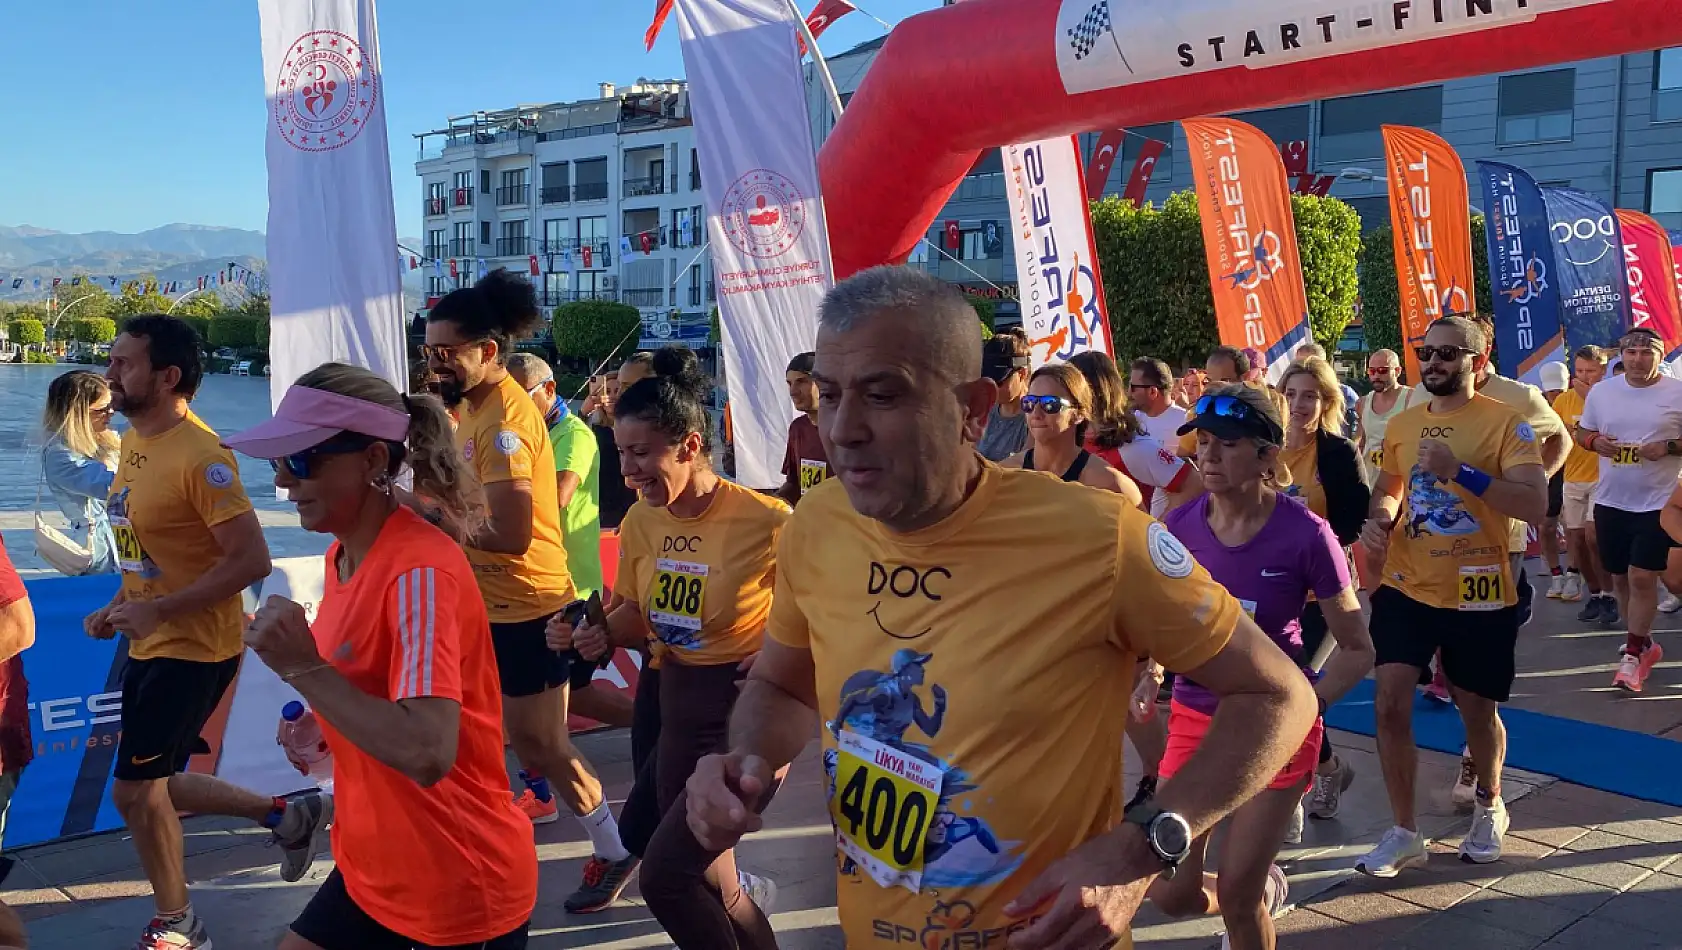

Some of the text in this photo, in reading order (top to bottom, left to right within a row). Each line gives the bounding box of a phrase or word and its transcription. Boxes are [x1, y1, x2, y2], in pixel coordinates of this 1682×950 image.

[1177, 0, 1528, 67] START-FIN
[1420, 427, 1454, 439] DOC
[662, 535, 702, 553] DOC
[655, 573, 702, 615] 308
[867, 561, 952, 600] DOC
[1462, 575, 1500, 602] 301
[875, 748, 904, 775] LİKYA
[841, 765, 928, 866] 400
